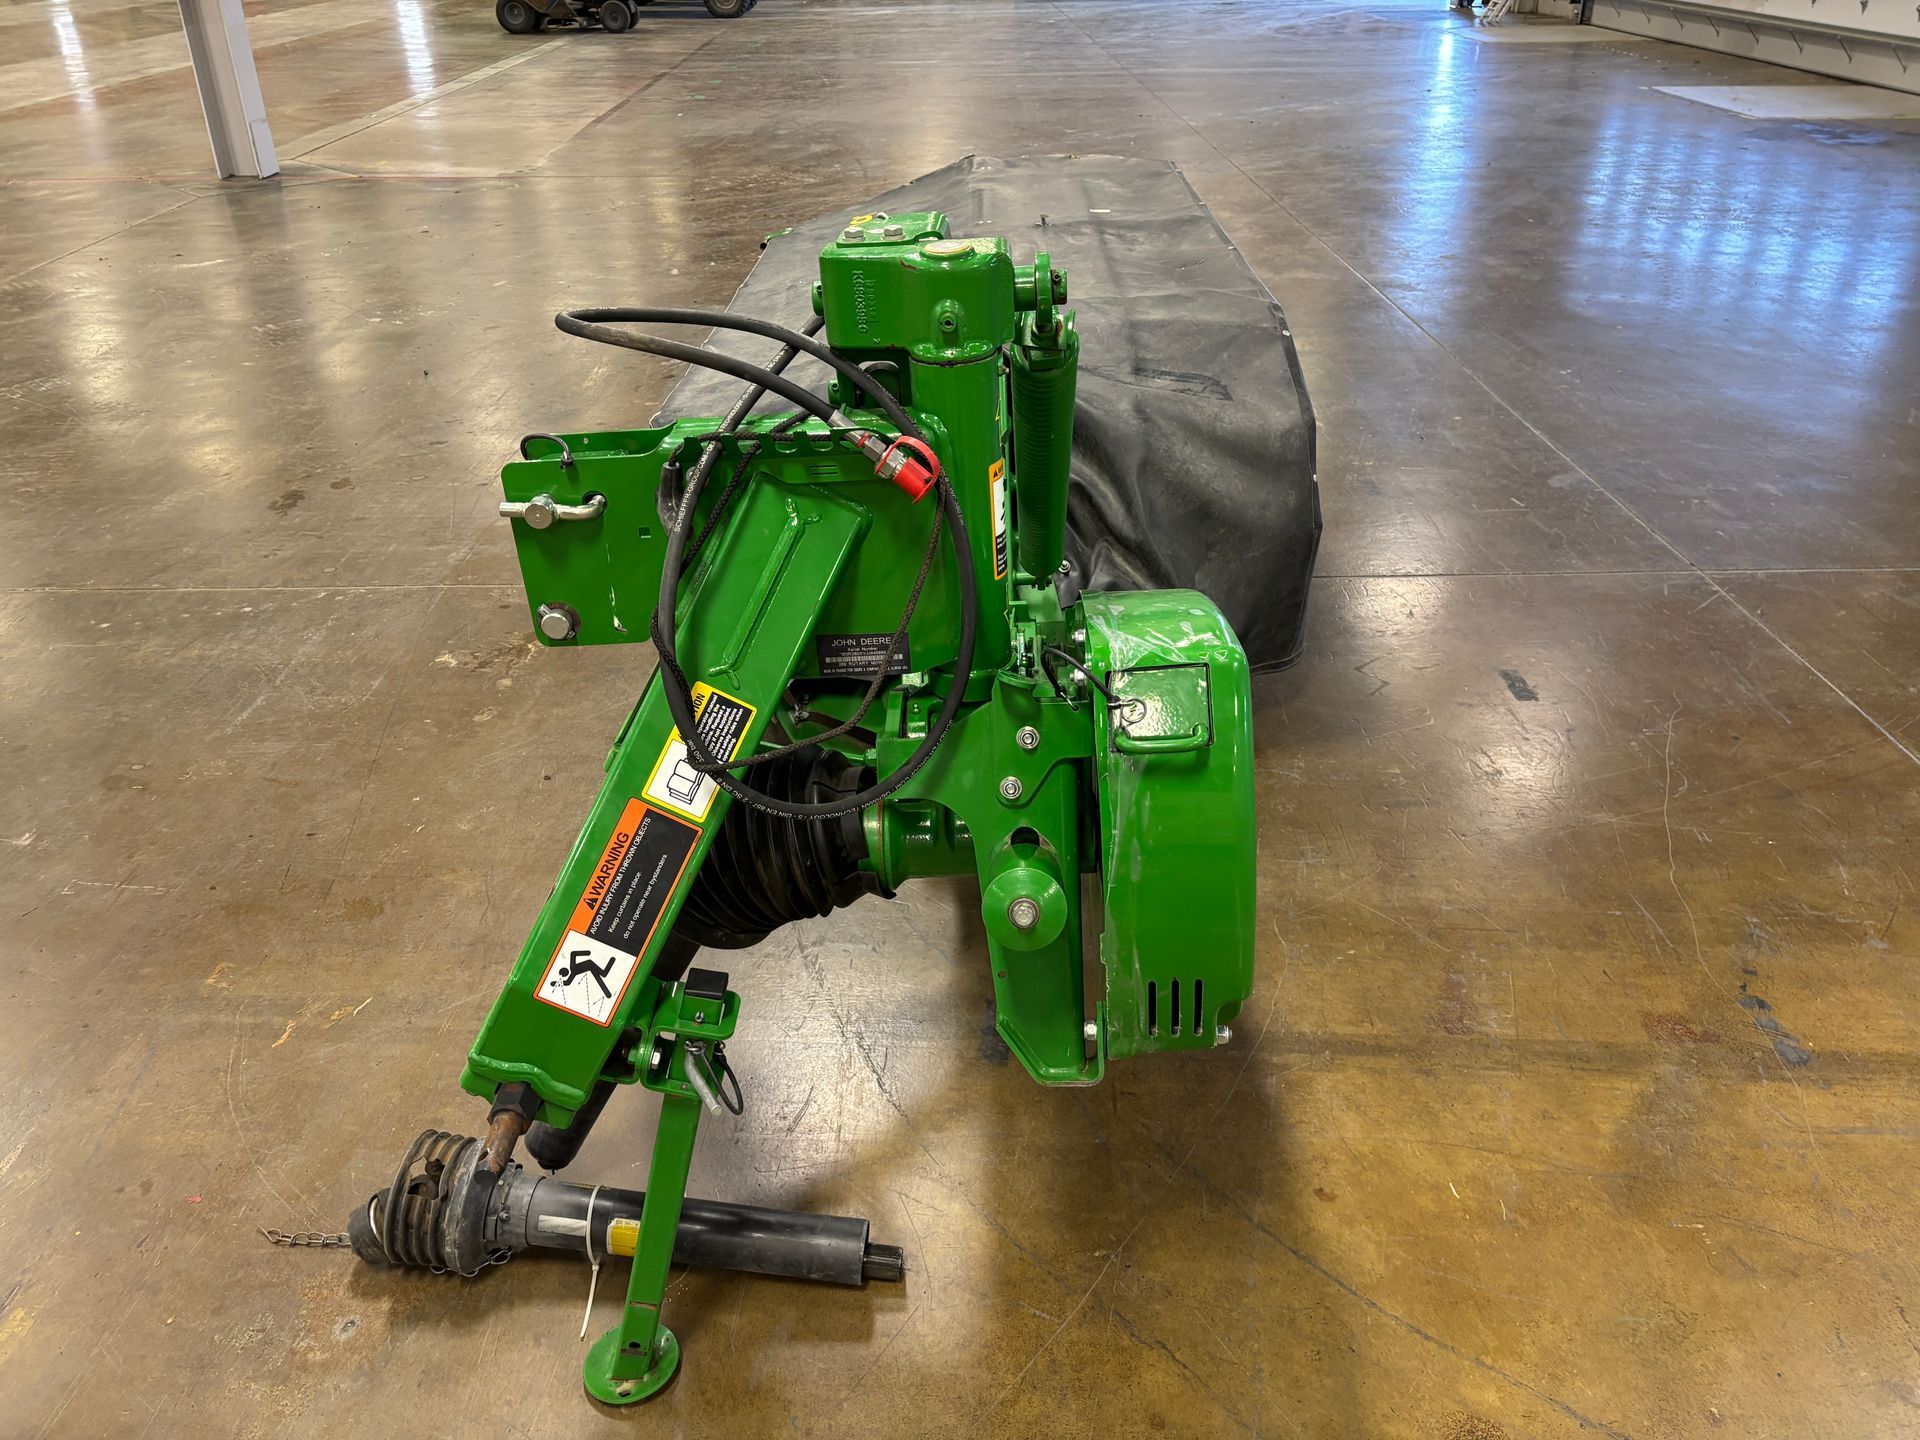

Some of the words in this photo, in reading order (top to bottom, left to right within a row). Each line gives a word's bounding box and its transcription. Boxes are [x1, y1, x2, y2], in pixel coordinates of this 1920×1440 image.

[831, 638, 856, 647] JOHN
[860, 637, 892, 646] DEERE
[589, 830, 630, 898] WARNING
[589, 913, 603, 934] AVOID
[598, 891, 614, 915] INJURY
[609, 872, 623, 892] FROM
[619, 844, 637, 874] THROWN
[632, 816, 650, 846] OBJECTS
[622, 929, 630, 939] do
[626, 919, 635, 930] not
[631, 897, 647, 921] operate
[642, 884, 652, 898] near
[648, 851, 669, 886] bystanders.
[607, 916, 620, 933] Keep
[615, 893, 630, 917] curtains
[629, 869, 643, 888] place.
